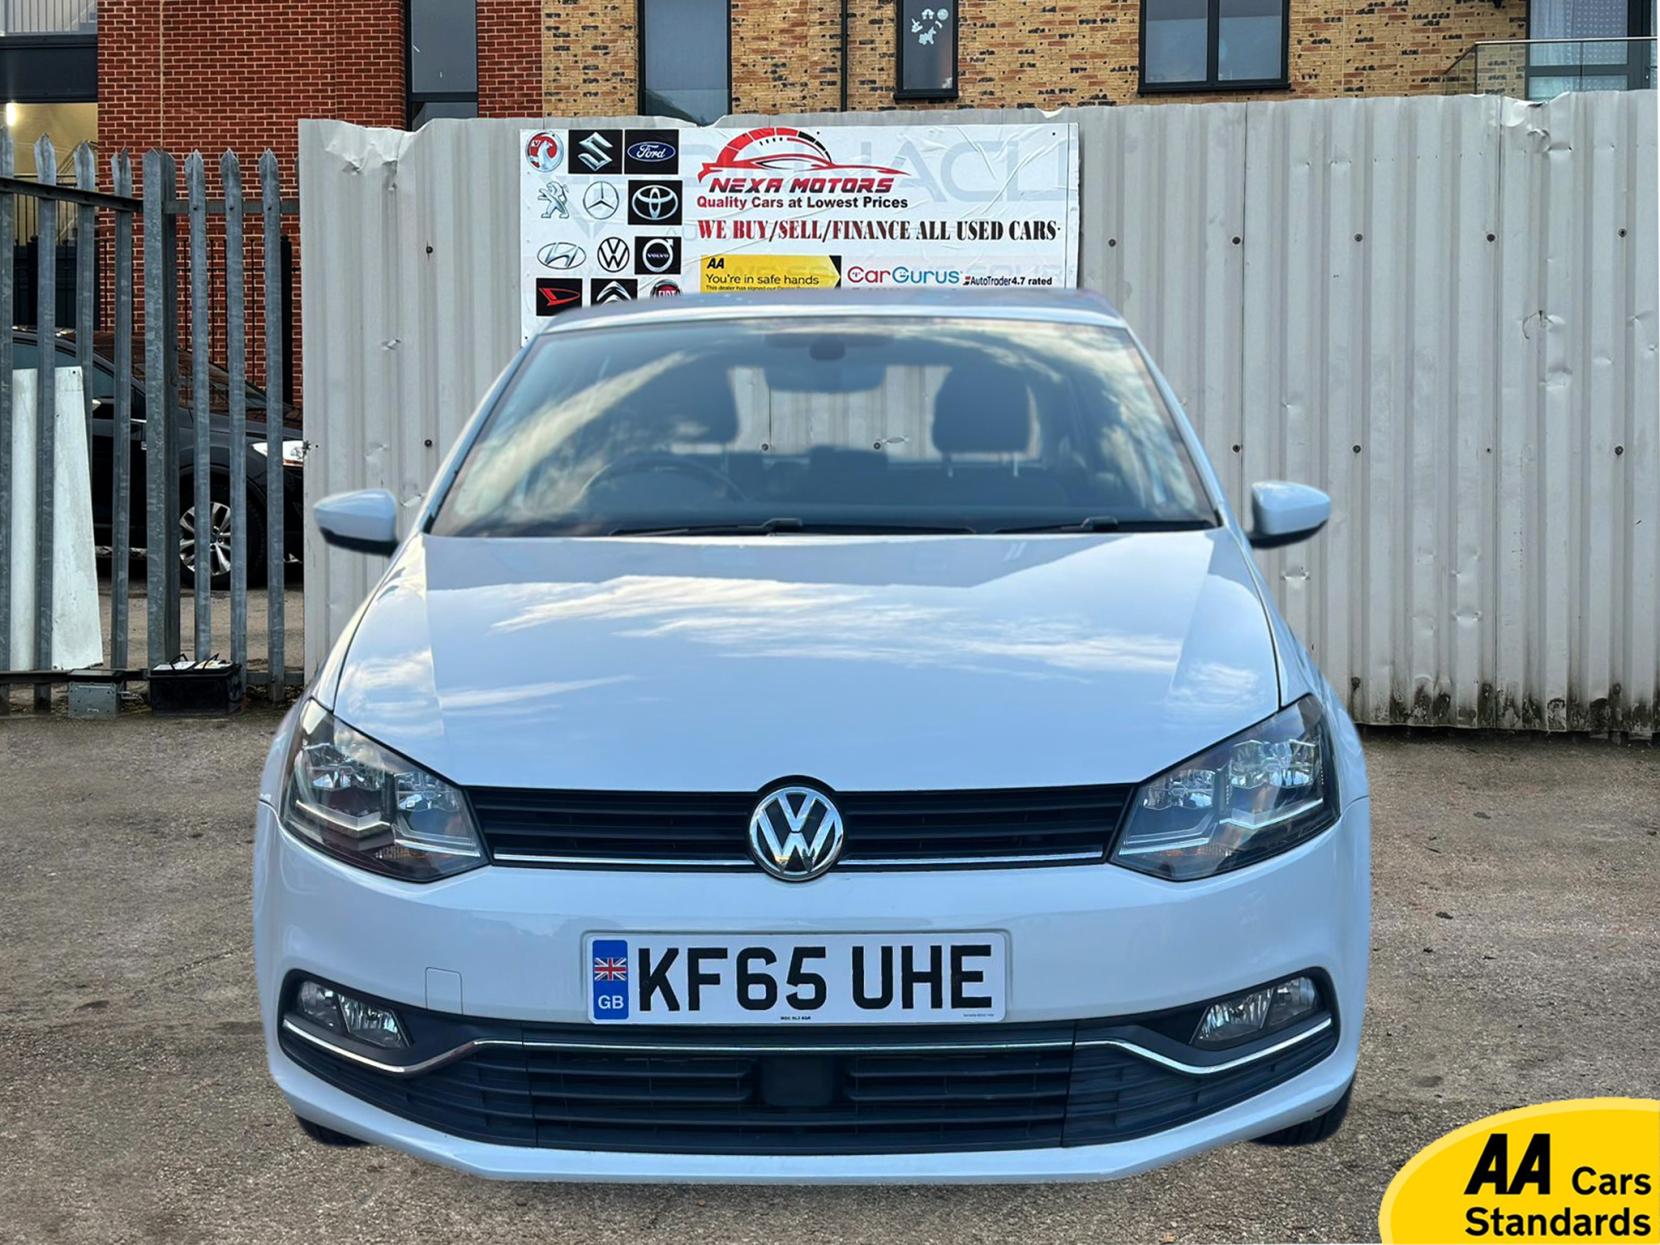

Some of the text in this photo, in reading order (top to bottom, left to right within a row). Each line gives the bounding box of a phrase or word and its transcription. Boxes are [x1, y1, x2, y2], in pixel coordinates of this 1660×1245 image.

[636, 144, 666, 159] Ford
[709, 178, 894, 193] NEXA MOTORS
[697, 196, 908, 210] Quality Cars at Lowest Prices
[698, 219, 727, 239] WE
[916, 220, 950, 240] ALL
[957, 220, 1003, 240] USED
[1009, 220, 1056, 240] CARS
[706, 258, 725, 269] AA
[705, 273, 819, 284] You're in safe hands
[847, 266, 960, 284] CarGurus
[1028, 277, 1052, 285] rated
[638, 944, 992, 1011] KF65 UHE
[598, 995, 624, 1009] GB
